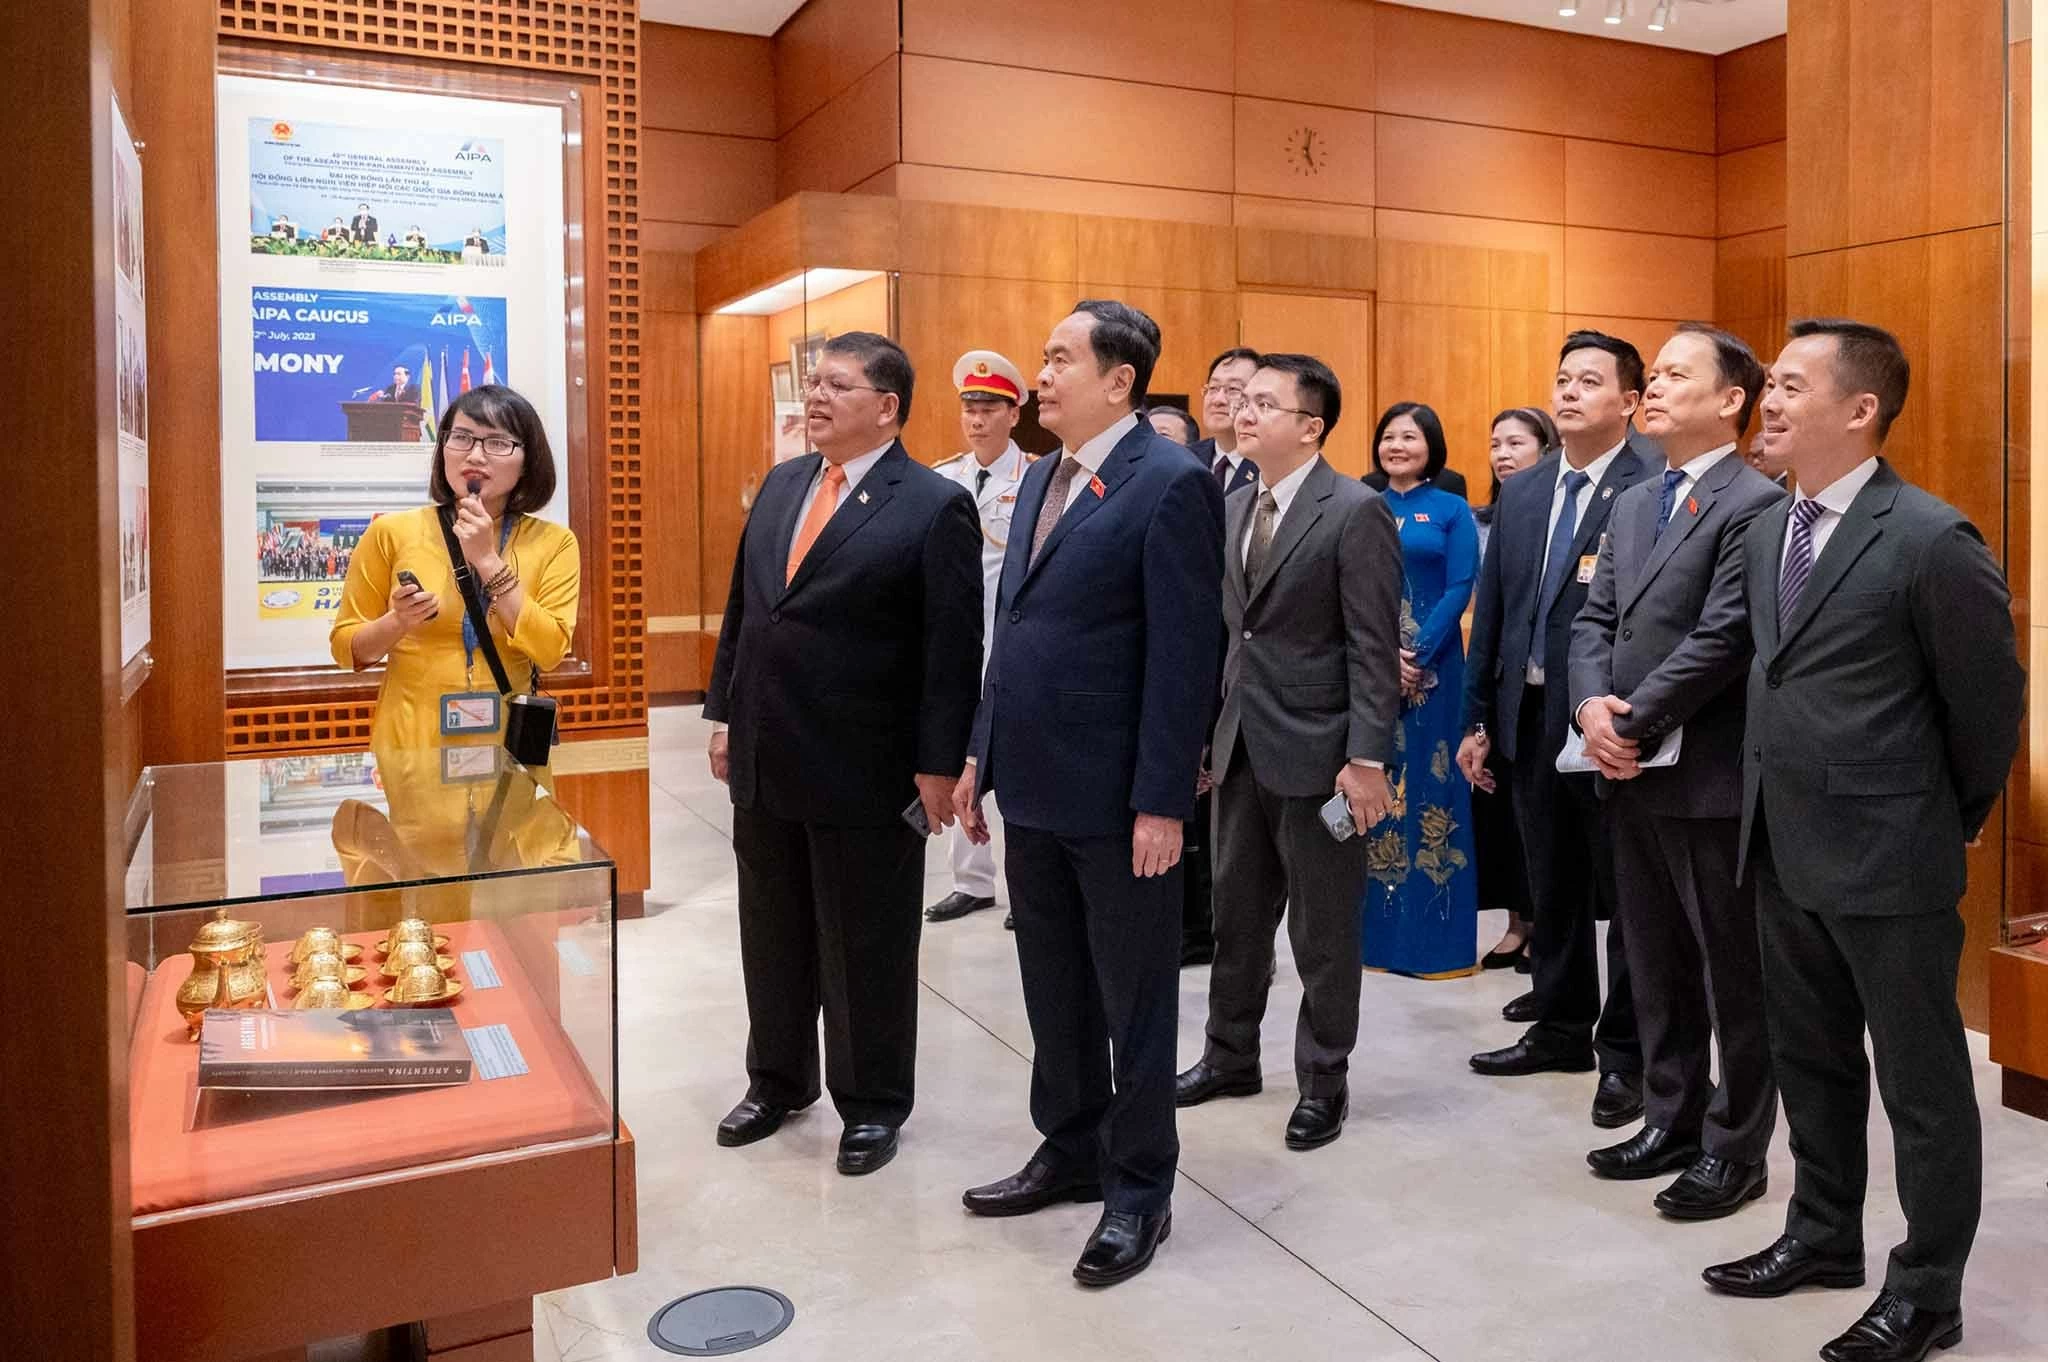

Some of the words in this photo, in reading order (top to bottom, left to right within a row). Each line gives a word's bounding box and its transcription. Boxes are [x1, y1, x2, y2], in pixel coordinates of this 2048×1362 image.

[386, 156, 427, 165] ASSEMBLY
[455, 152, 492, 162] AIPA
[314, 157, 340, 165] ASEAN
[432, 168, 473, 176] ASSEMBLY
[253, 290, 318, 303] ASSEMBLY
[294, 308, 369, 324] CAUCUS
[431, 313, 482, 326] AIPA
[254, 352, 344, 374] MONY
[388, 1067, 449, 1075] ARGENTINA
